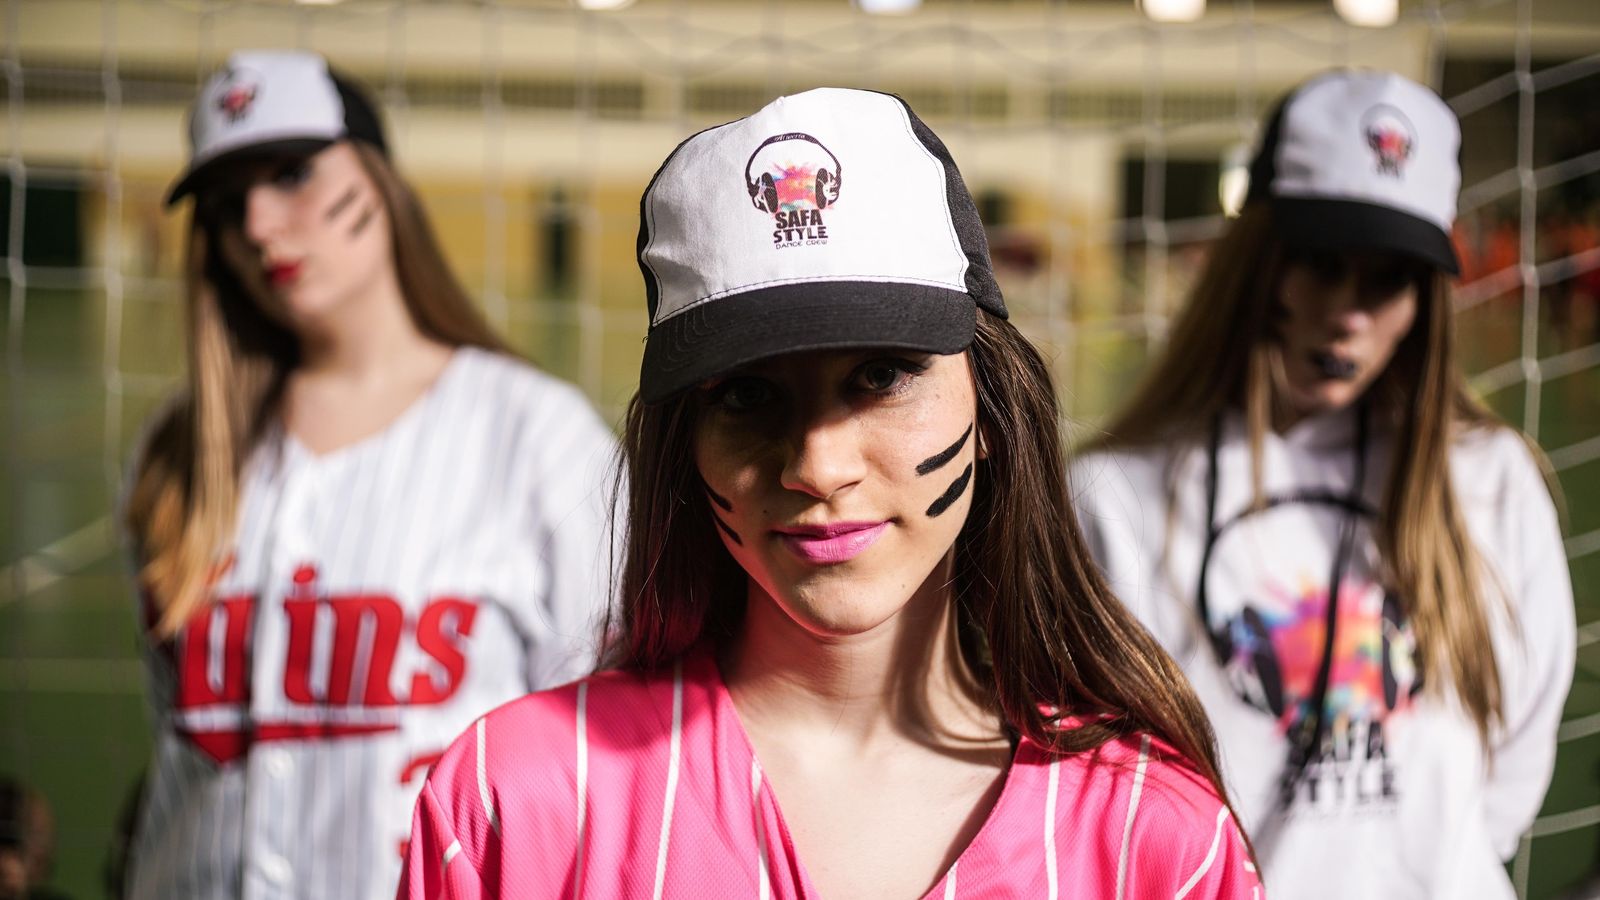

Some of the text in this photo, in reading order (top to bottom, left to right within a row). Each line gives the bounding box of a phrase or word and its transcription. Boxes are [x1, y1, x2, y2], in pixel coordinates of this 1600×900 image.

[775, 209, 823, 229] SAFA
[773, 226, 828, 243] STYLE
[775, 241, 803, 249] DANCE
